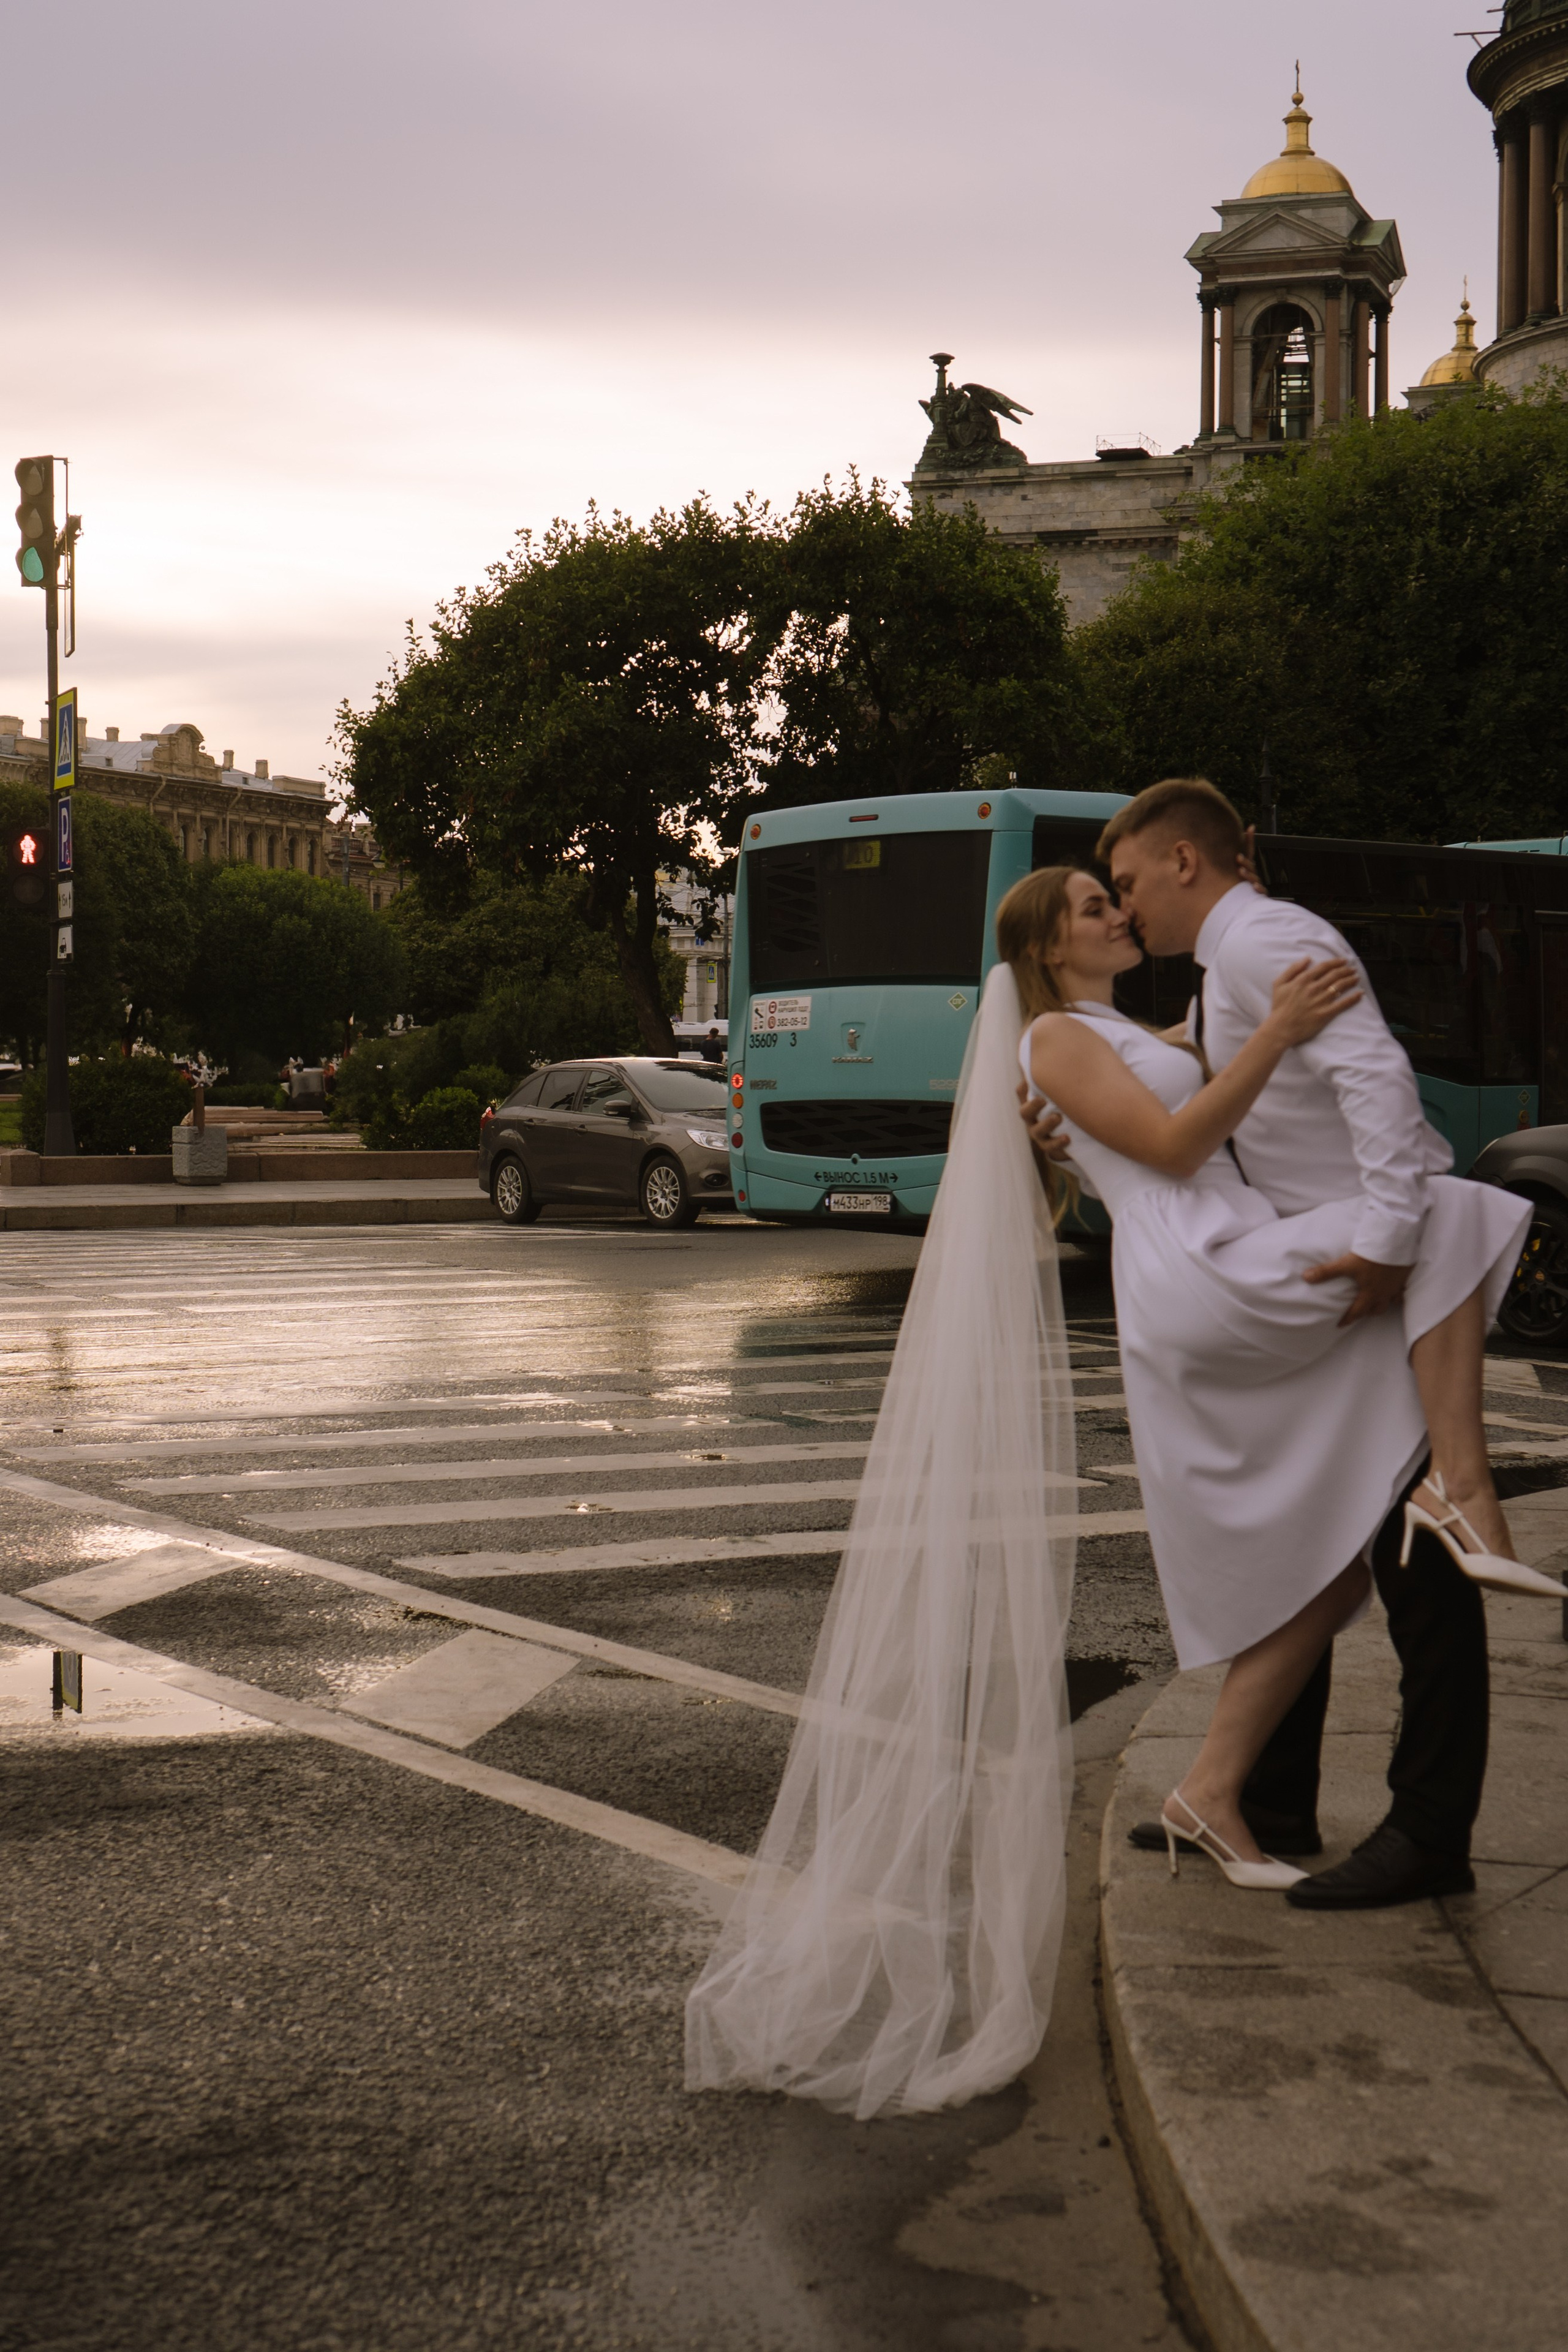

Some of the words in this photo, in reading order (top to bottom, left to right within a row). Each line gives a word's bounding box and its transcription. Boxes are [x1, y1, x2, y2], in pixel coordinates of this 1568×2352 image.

[61, 807, 69, 862] P
[777, 1017, 808, 1027] 382-05-12
[749, 1033, 778, 1049] 35609
[790, 1032, 797, 1047] 3
[823, 1172, 861, 1184] ВЫНОС
[863, 1171, 876, 1184] 1.5
[880, 1172, 889, 1184] М
[872, 1196, 888, 1206] 198
